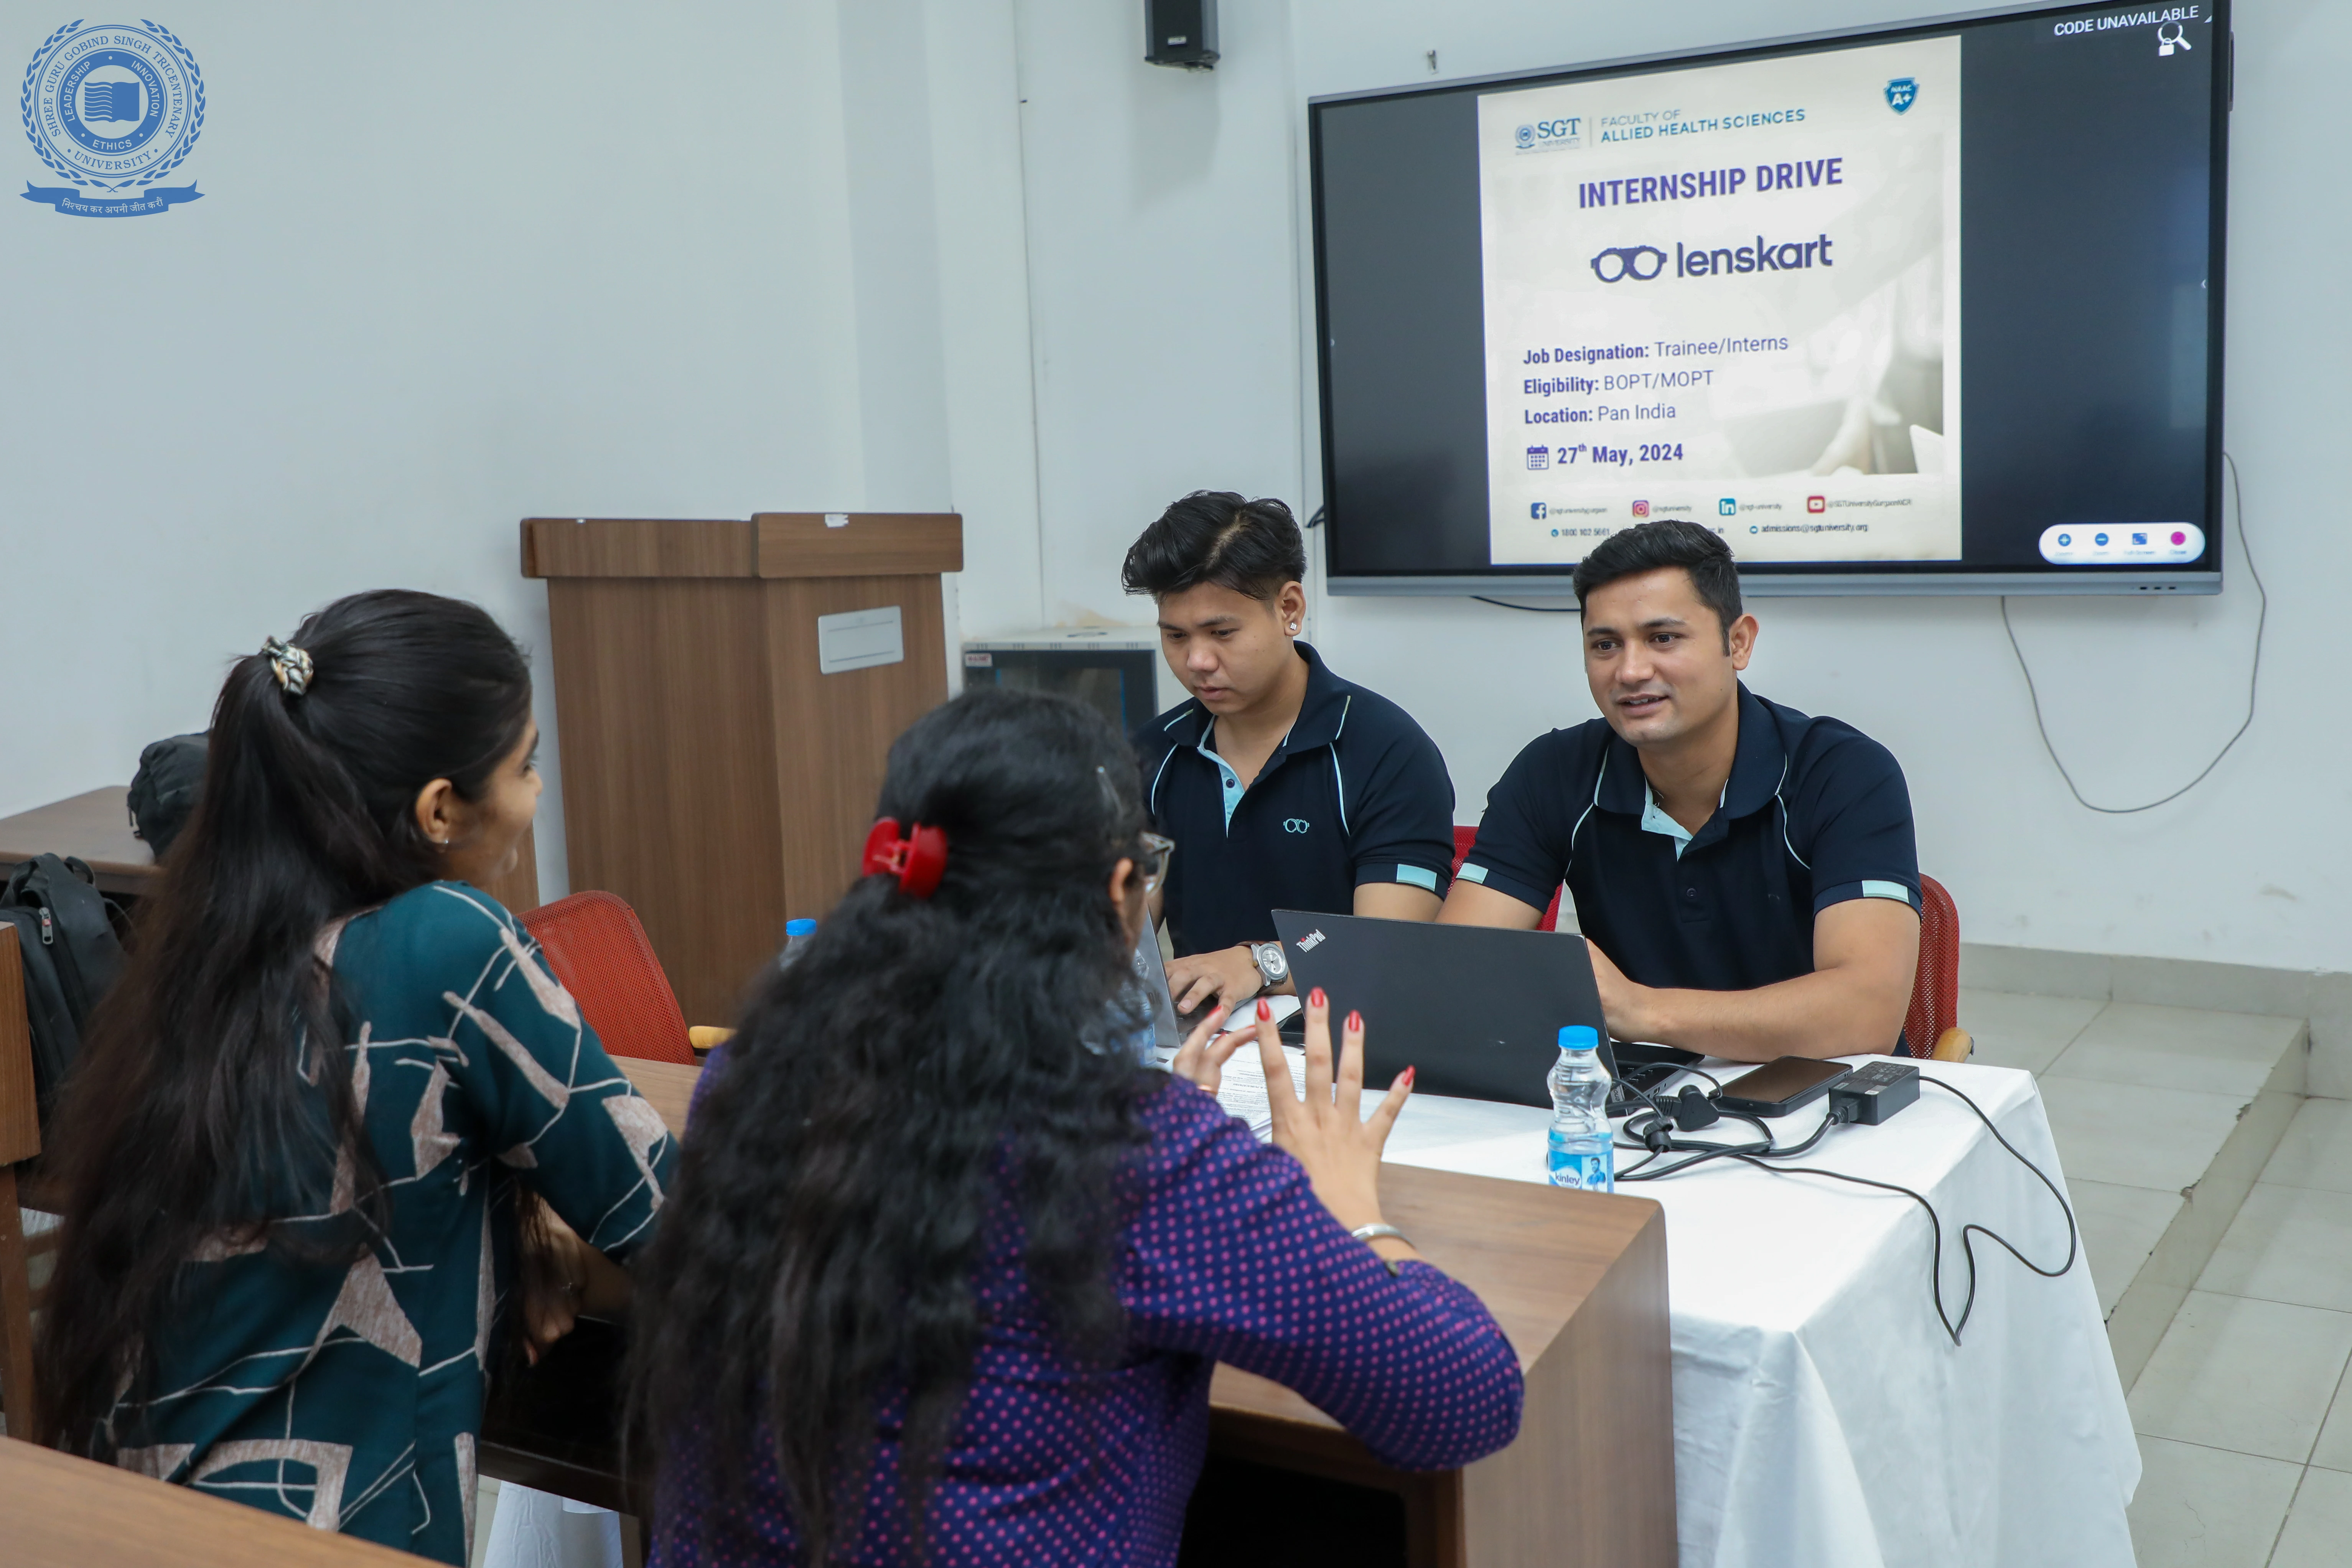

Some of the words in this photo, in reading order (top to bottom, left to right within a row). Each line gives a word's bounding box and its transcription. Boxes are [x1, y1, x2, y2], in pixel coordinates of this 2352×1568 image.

[2054, 19, 2094, 36] CODE
[2097, 5, 2199, 30] UNAVAILABLE
[1892, 93, 1912, 105] A+
[1537, 117, 1581, 138] SGT
[1601, 112, 1659, 128] FACULTY
[1662, 109, 1681, 121] OF
[1601, 122, 1654, 143] ALLIED
[1659, 117, 1718, 136] HEALTH
[1723, 109, 1805, 130] SCIENCES
[1579, 168, 1746, 209] INTERNSHIP
[1756, 157, 1843, 192] DRIVE
[1677, 234, 1833, 278] lenskart
[1523, 348, 1550, 364] Job
[1554, 343, 1649, 365] Designation:
[1654, 337, 1789, 357] Trainee/Interns
[1524, 377, 1599, 397] Eligibility:
[1604, 369, 1714, 390] BOPT/MOPT
[1525, 407, 1593, 424] Location:
[1598, 405, 1629, 421] Pan
[1636, 402, 1676, 420] India
[1557, 443, 1587, 464] 27th
[1592, 446, 1633, 467] May,
[1639, 443, 1683, 461] 2024
[1580, 528, 1592, 536] 102
[1296, 929, 1326, 953] ThinkPad
[1555, 1172, 1580, 1186] kinley
